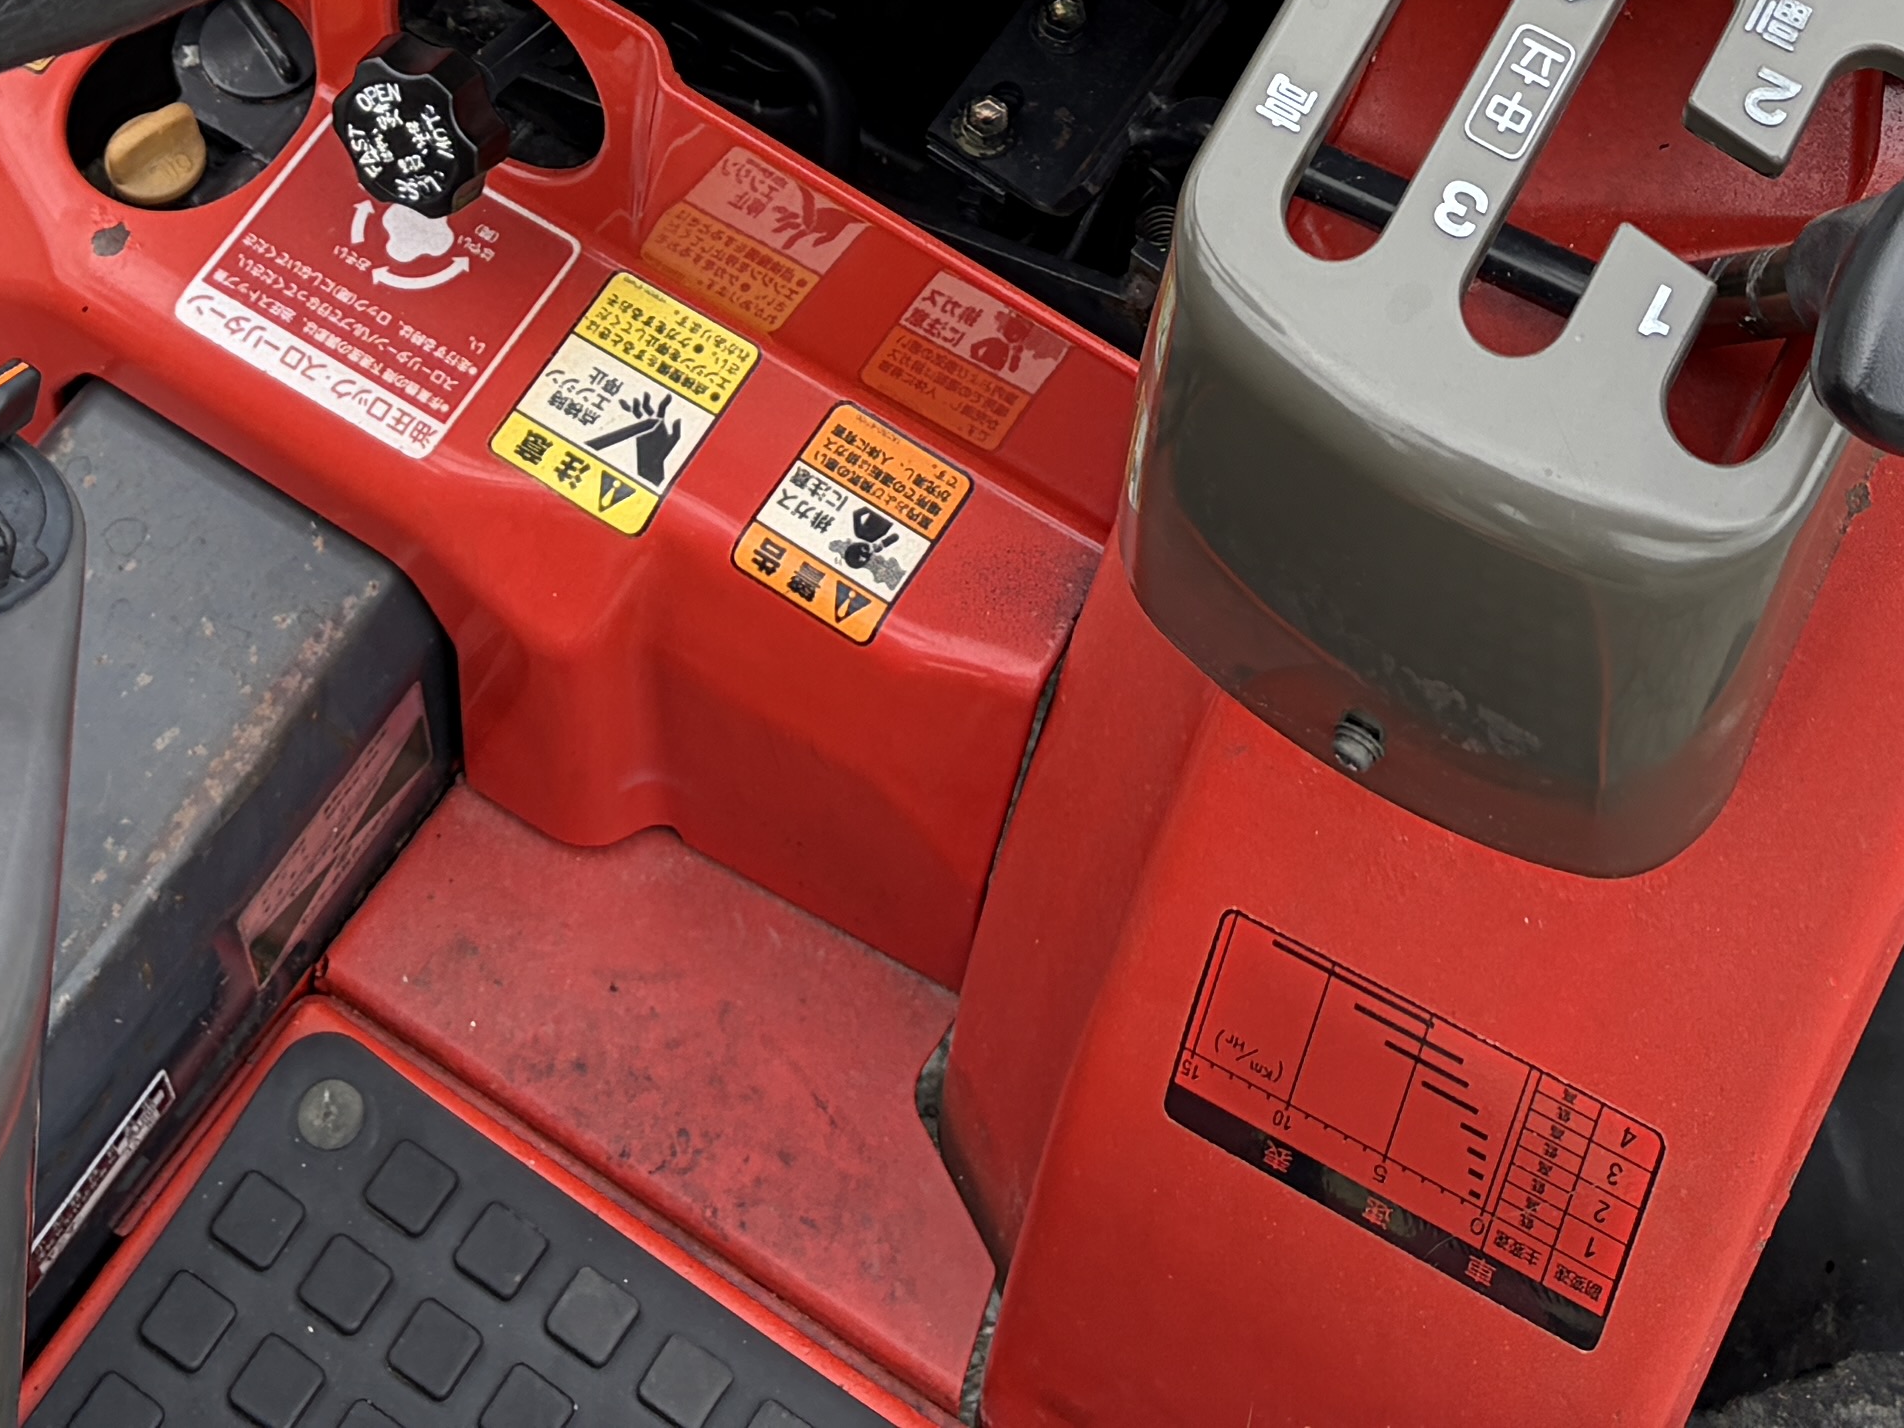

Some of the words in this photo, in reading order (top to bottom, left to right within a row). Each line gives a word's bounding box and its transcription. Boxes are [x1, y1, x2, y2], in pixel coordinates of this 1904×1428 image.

[355, 83, 400, 111] OPEN
[1255, 73, 1318, 132] 高
[1486, 36, 1566, 132] 中立
[1744, 66, 1803, 127] 2
[347, 123, 382, 177] FAST
[1434, 180, 1489, 238] 3
[604, 292, 693, 349] ケガをするおそ
[1638, 284, 1673, 336] 1
[594, 306, 732, 390] エンジンを停止してくだ
[668, 309, 752, 363] れがあります。
[543, 364, 612, 412] エンジン
[584, 365, 624, 397] 停止
[546, 388, 601, 430] 点検時
[511, 427, 592, 491] 注意
[926, 463, 960, 490] です。
[773, 487, 835, 535] 排ガス
[788, 465, 849, 513] に注意
[746, 534, 828, 603] 警告
[1177, 1057, 1204, 1082] 15
[1269, 1107, 1296, 1131] 10
[1617, 1126, 1639, 1151] 4
[1369, 1160, 1391, 1183] 5
[1603, 1160, 1625, 1187] 3
[1256, 1139, 1499, 1288] 車速表
[1466, 1214, 1487, 1237] 0
[1590, 1199, 1612, 1224] 2
[1582, 1236, 1601, 1260] 1
